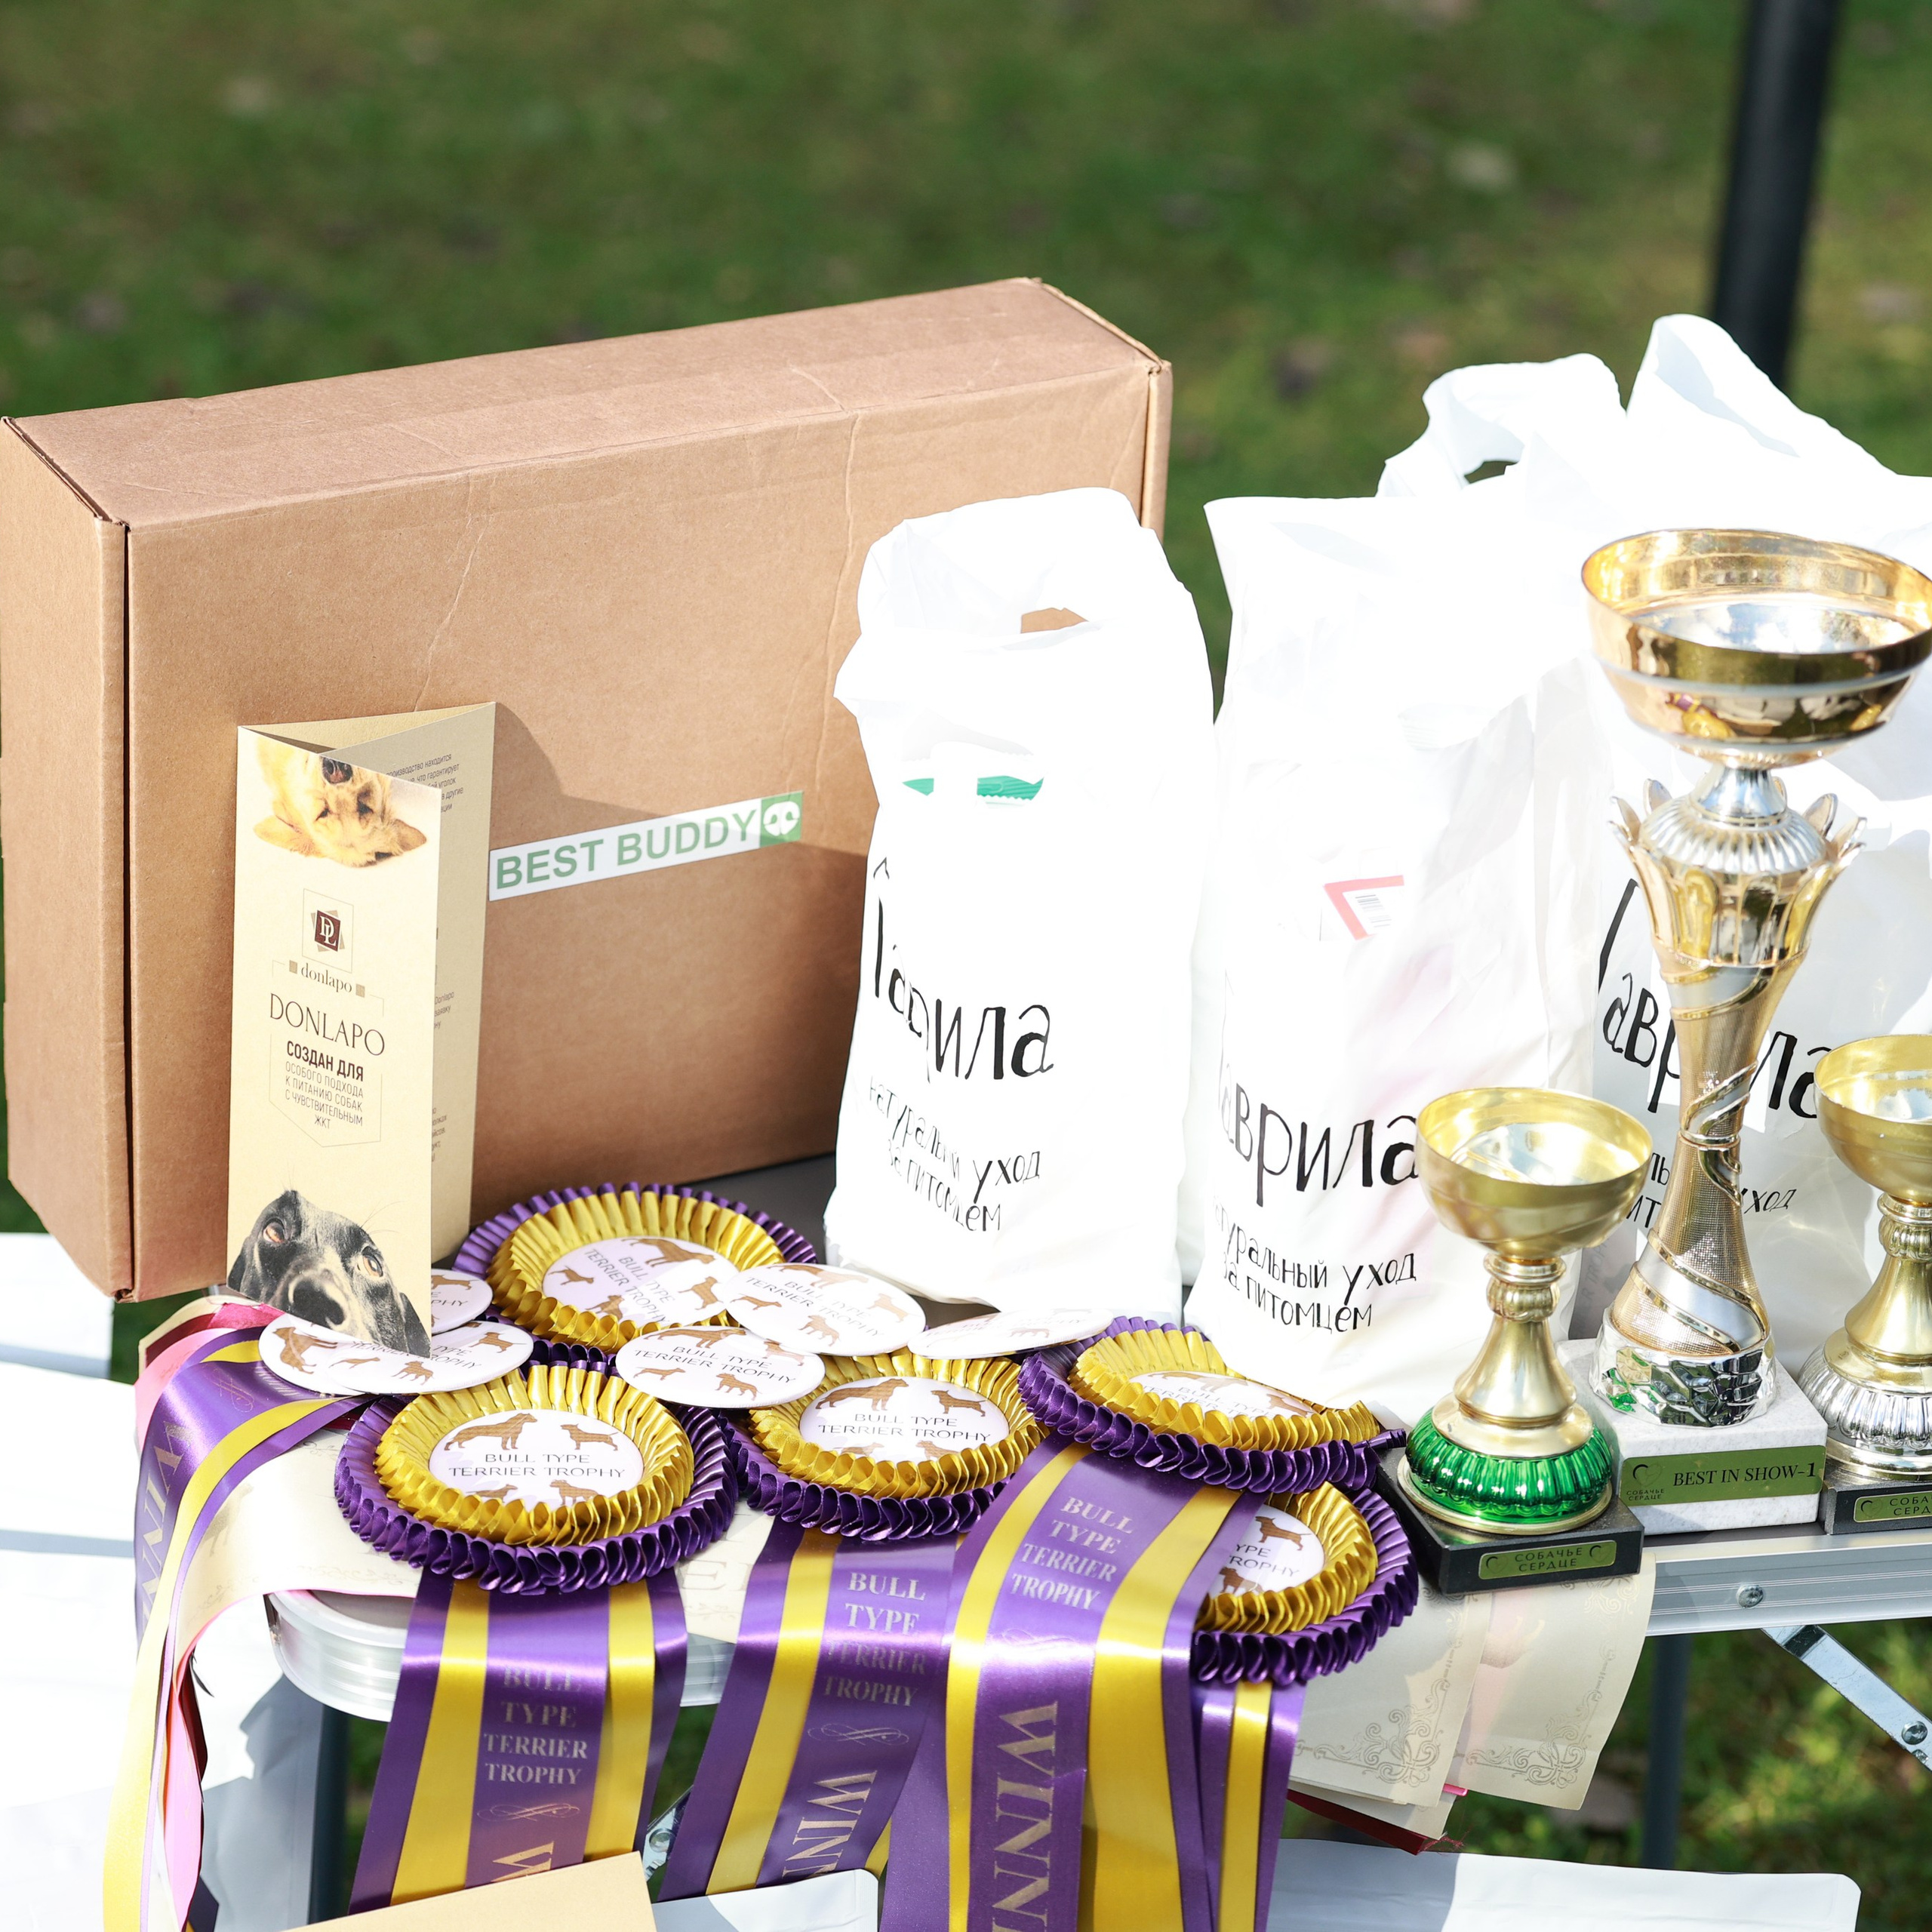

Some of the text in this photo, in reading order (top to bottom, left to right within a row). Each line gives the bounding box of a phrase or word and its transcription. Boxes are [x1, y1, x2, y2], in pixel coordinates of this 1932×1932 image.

[497, 809, 757, 889] BEST BUDDY
[301, 962, 352, 993] donlapo
[270, 992, 385, 1056] DONLAPO
[287, 1040, 364, 1082] СОЗДАН ДЛЯ
[285, 1060, 364, 1099] ОСОБОГО ПОДХОДА
[285, 1075, 363, 1113] К ПИТАНИЮ СОБАК
[285, 1088, 364, 1127] С ЧУВСТВИТЕЛЬНЫМ
[314, 1114, 331, 1130] ЖКТ
[972, 1151, 1041, 1205] уход
[1740, 1187, 1798, 1214] ход
[584, 1248, 629, 1287] TERRIER
[618, 1255, 676, 1304] BULL TYPE
[1342, 1253, 1417, 1306] уход
[746, 1276, 814, 1308] TERRIER
[1222, 1251, 1373, 1335] за питомцем
[428, 1353, 481, 1369] ROPHY
[635, 1349, 796, 1384] TERRIER TROPHY
[673, 1346, 773, 1369] BULL TYPE
[1178, 1386, 1225, 1407] BULL
[818, 1425, 992, 1442] TERRIER TROPHY
[854, 1414, 958, 1427] BULL TYPE
[448, 1466, 626, 1478] TERRIER TROPHY
[485, 1454, 591, 1464] BULL TYPE
[1673, 1462, 1817, 1487] BEST IN SHOW-1
[1626, 1488, 1666, 1497] СОБАЧЬЕ
[1889, 1496, 1932, 1507] СОБА
[1060, 1496, 1134, 1534] BULL
[1048, 1519, 1121, 1555] TYPE
[1235, 1543, 1271, 1558] YPE
[1020, 1543, 1118, 1583] TERRIER
[1228, 1555, 1300, 1577] ROPHY
[1514, 1547, 1583, 1563] СОБАЧЬЕ
[1518, 1558, 1577, 1572] СЕРДЦЕ
[847, 1571, 927, 1601] BULL
[1010, 1573, 1101, 1611] TROPHY
[823, 1675, 918, 1707] TROPHY
[500, 1701, 577, 1728] TYPE
[484, 1733, 588, 1759] TERRIER
[485, 1763, 582, 1786] TROPHY
[992, 1700, 1058, 1932] WINN
